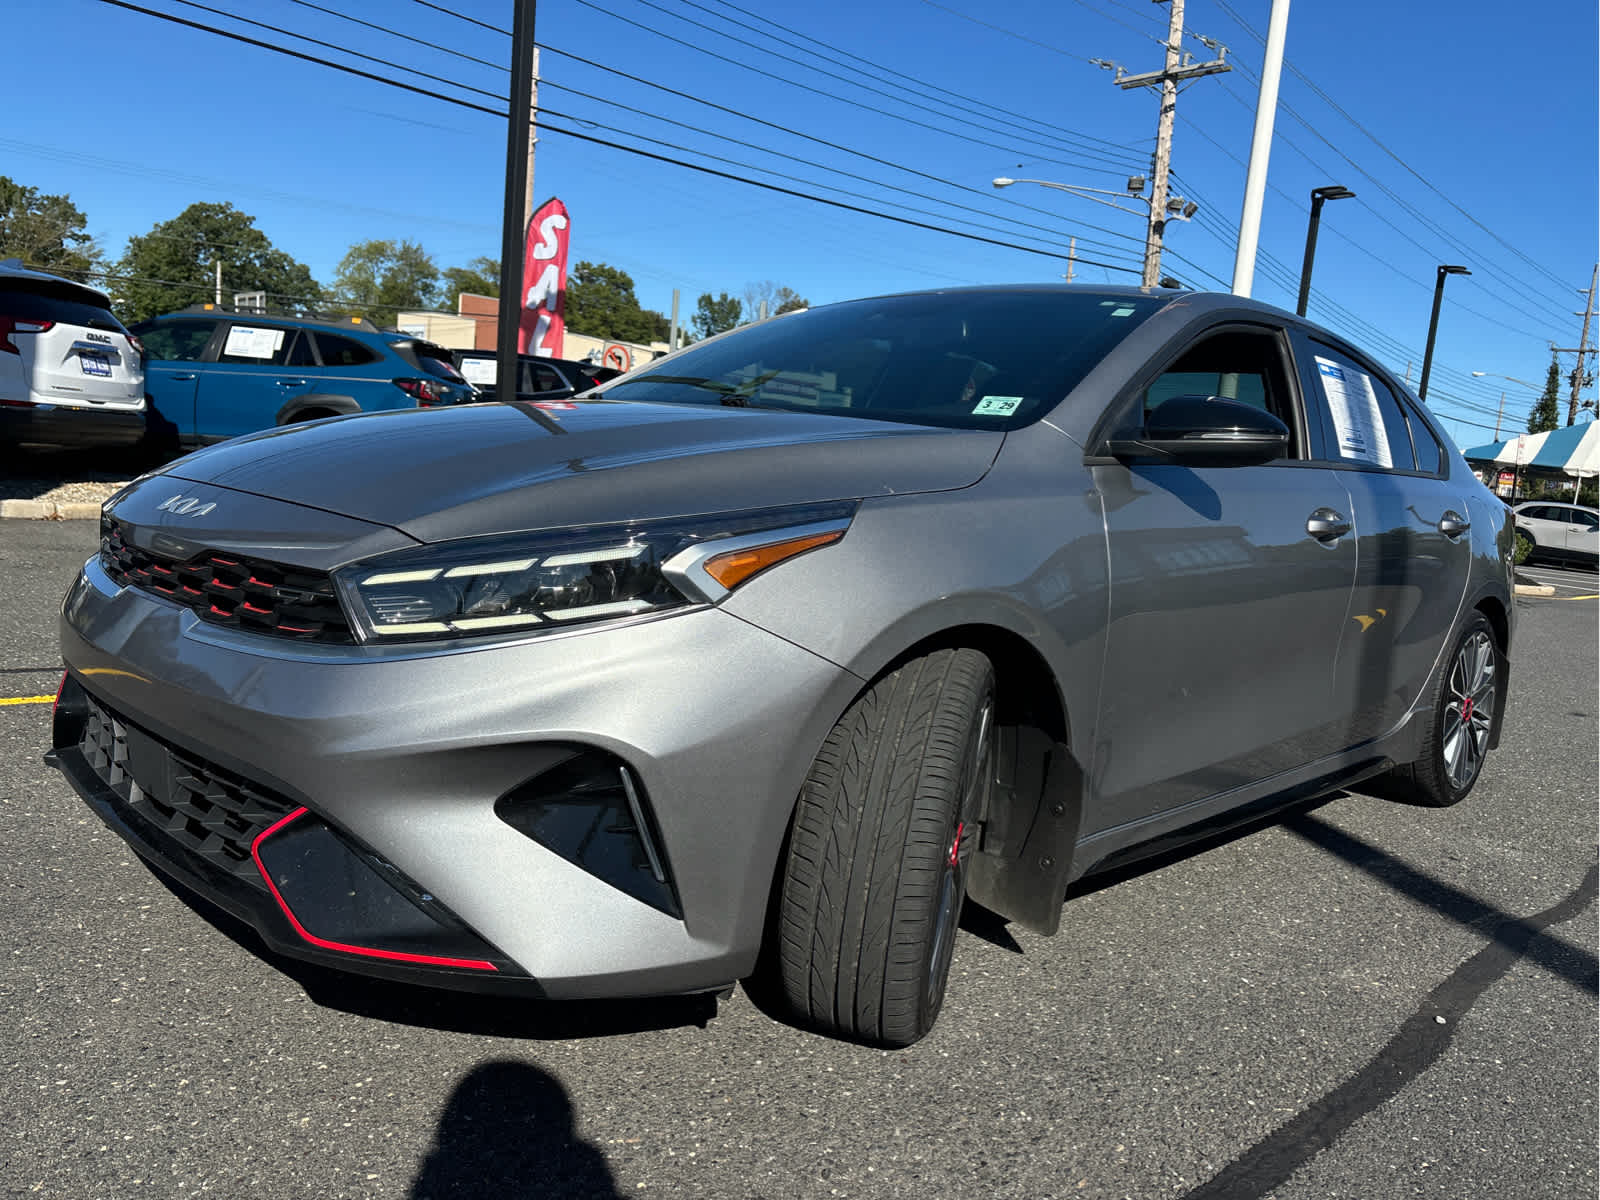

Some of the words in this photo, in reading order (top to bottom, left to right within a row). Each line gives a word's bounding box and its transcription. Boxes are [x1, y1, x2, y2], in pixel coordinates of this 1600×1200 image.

[86, 332, 112, 344] GMC
[982, 400, 993, 409] 3
[998, 401, 1016, 410] 29
[156, 494, 217, 518] KIA
